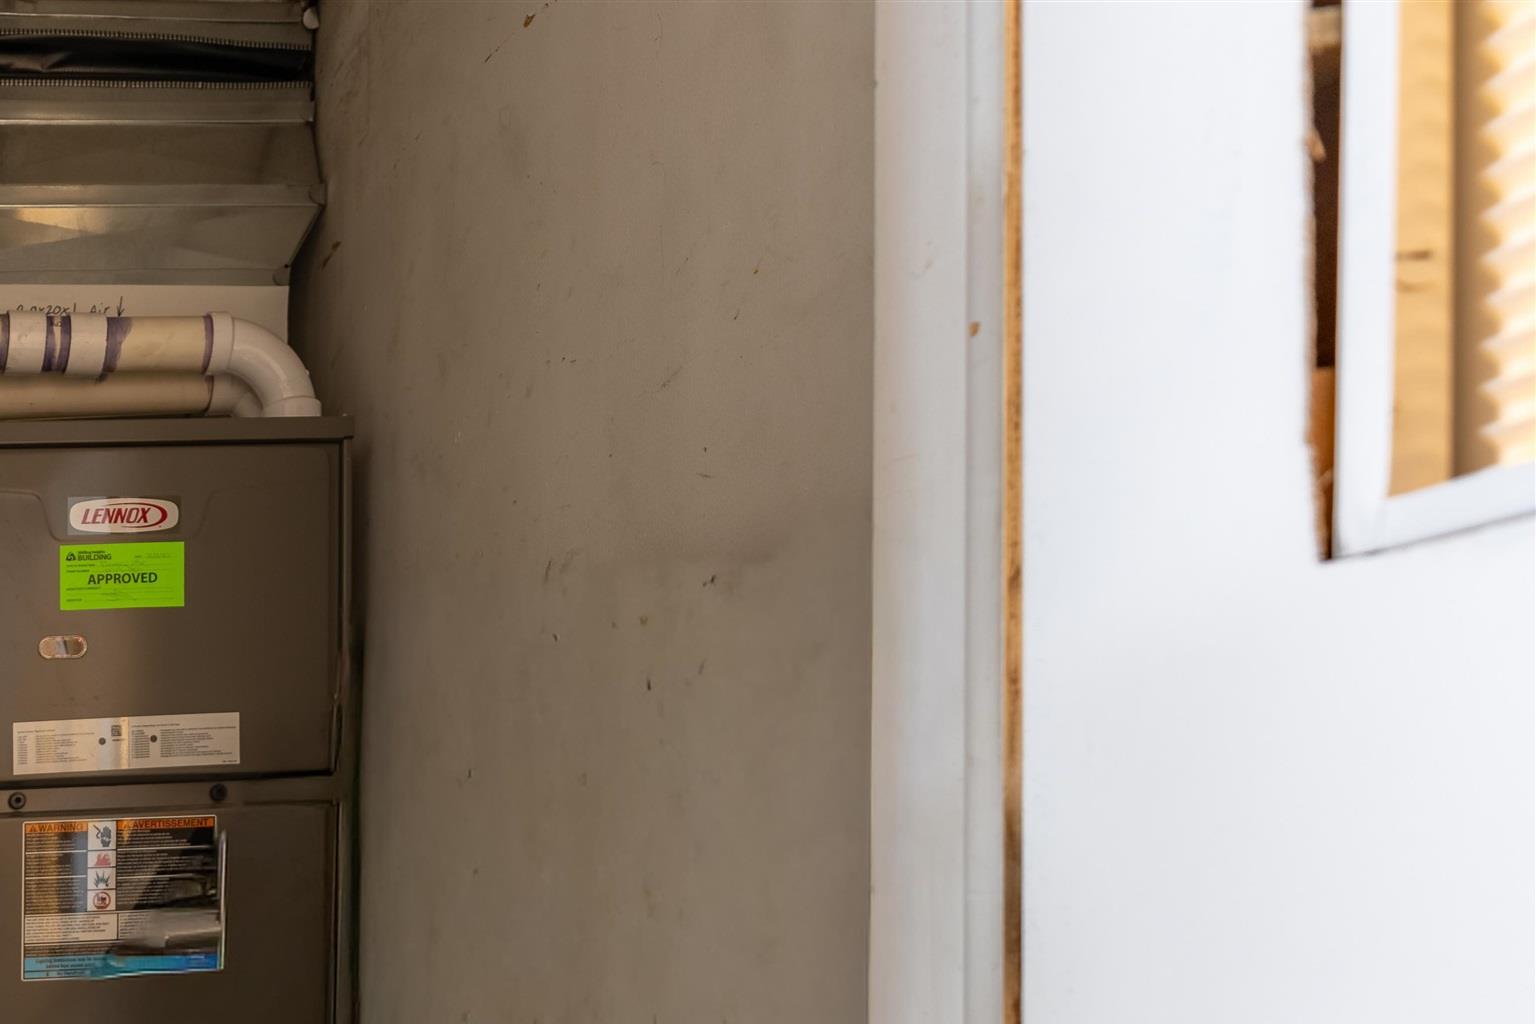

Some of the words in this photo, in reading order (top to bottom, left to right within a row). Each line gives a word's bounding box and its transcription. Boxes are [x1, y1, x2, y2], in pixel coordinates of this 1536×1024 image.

[81, 507, 152, 525] LENNOX
[77, 553, 112, 561] BUILDING
[87, 572, 158, 585] APPROVED
[38, 823, 83, 832] WARNING
[133, 818, 209, 828] AVERTISSEMENT
